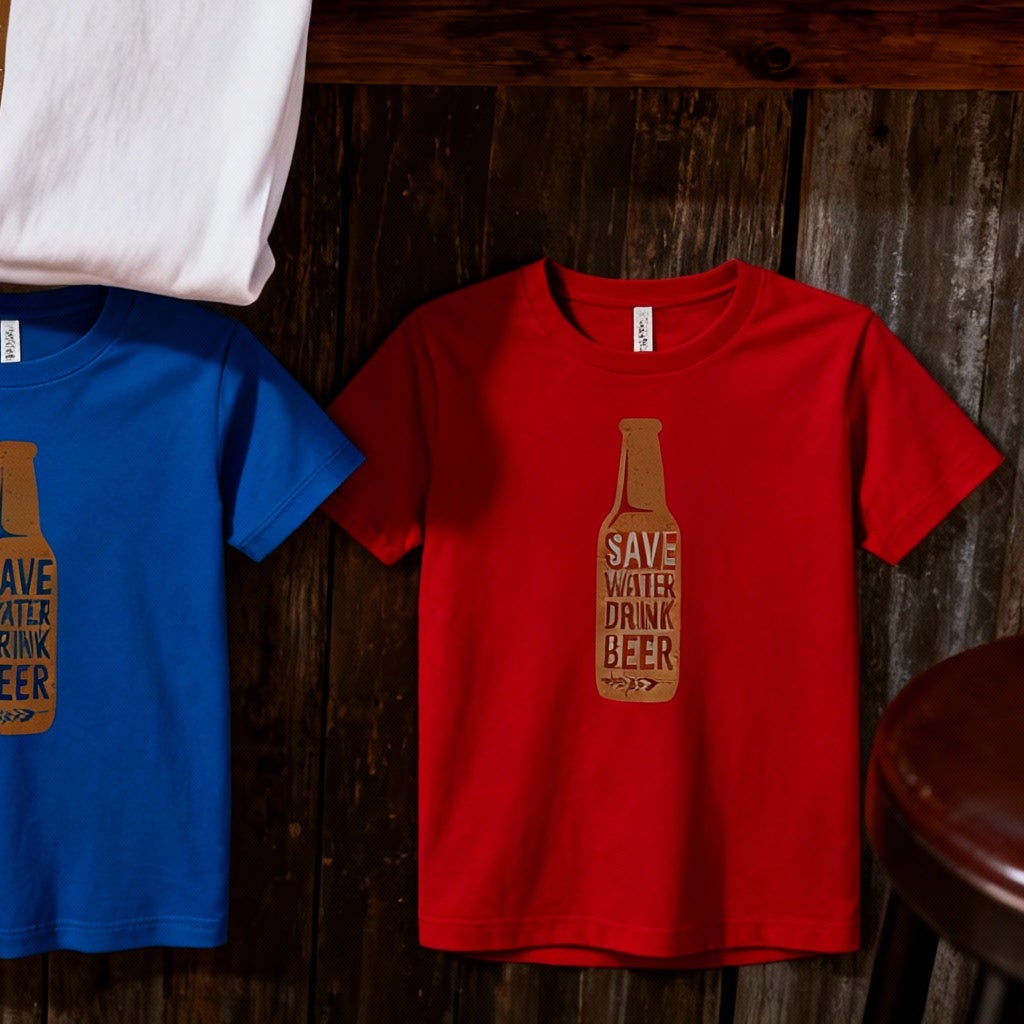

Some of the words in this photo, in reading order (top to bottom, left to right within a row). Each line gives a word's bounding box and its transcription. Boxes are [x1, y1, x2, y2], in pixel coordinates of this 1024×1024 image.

[605, 531, 677, 570] SAVE
[604, 571, 676, 598] WATER
[604, 634, 673, 671] BEER
